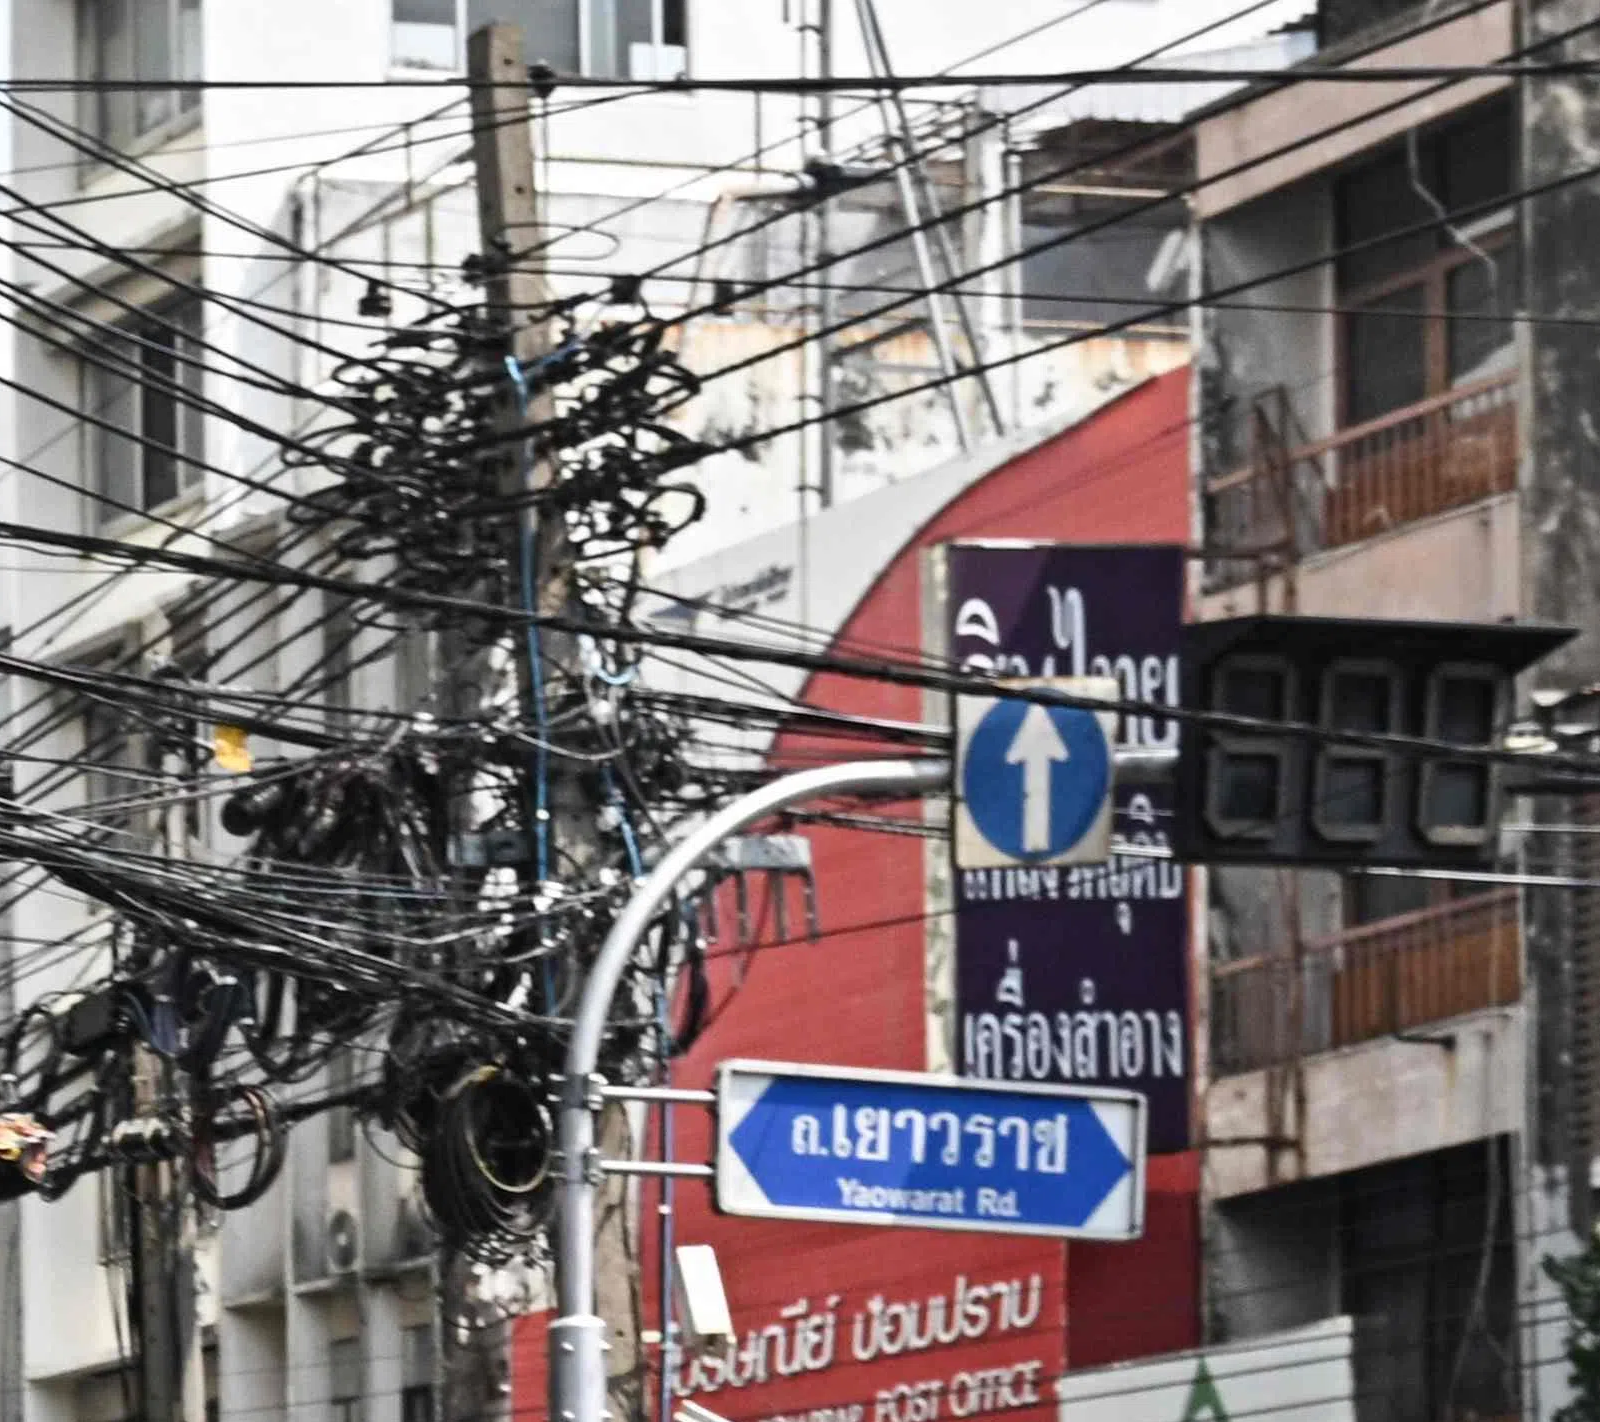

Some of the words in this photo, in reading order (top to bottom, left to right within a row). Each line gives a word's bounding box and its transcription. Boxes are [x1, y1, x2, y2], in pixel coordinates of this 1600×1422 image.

[964, 938, 1183, 1079] เครื่องสำอาง
[791, 1103, 1068, 1174] ถ.เยาวราช
[836, 1178, 965, 1214] Yaowarat
[976, 1187, 1020, 1217] Rd.
[852, 1274, 1041, 1361] ป้อมปราบ
[950, 1360, 1042, 1417] OFFICE
